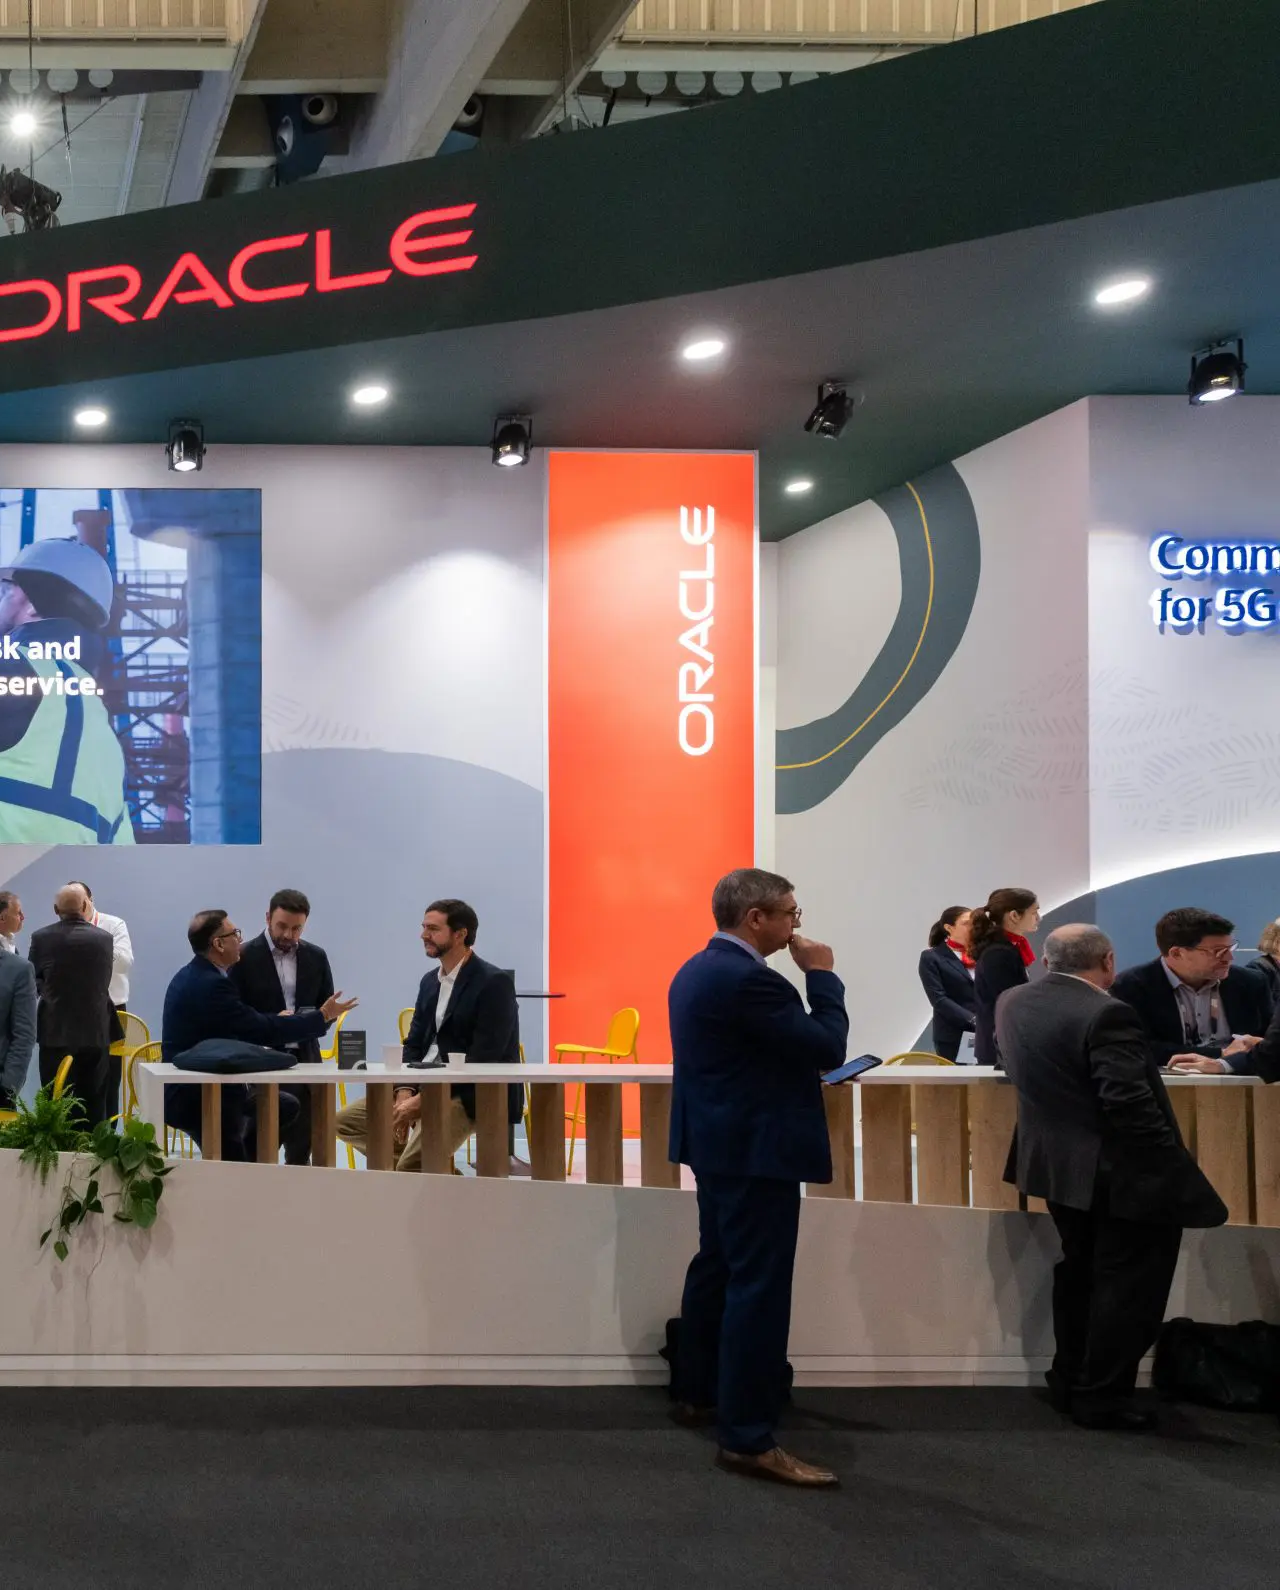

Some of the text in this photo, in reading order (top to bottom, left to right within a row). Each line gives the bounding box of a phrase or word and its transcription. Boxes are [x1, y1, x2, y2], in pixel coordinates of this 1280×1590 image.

[1158, 588, 1277, 621] for 5G
[28, 634, 81, 660] and
[678, 504, 715, 757] ORACLE
